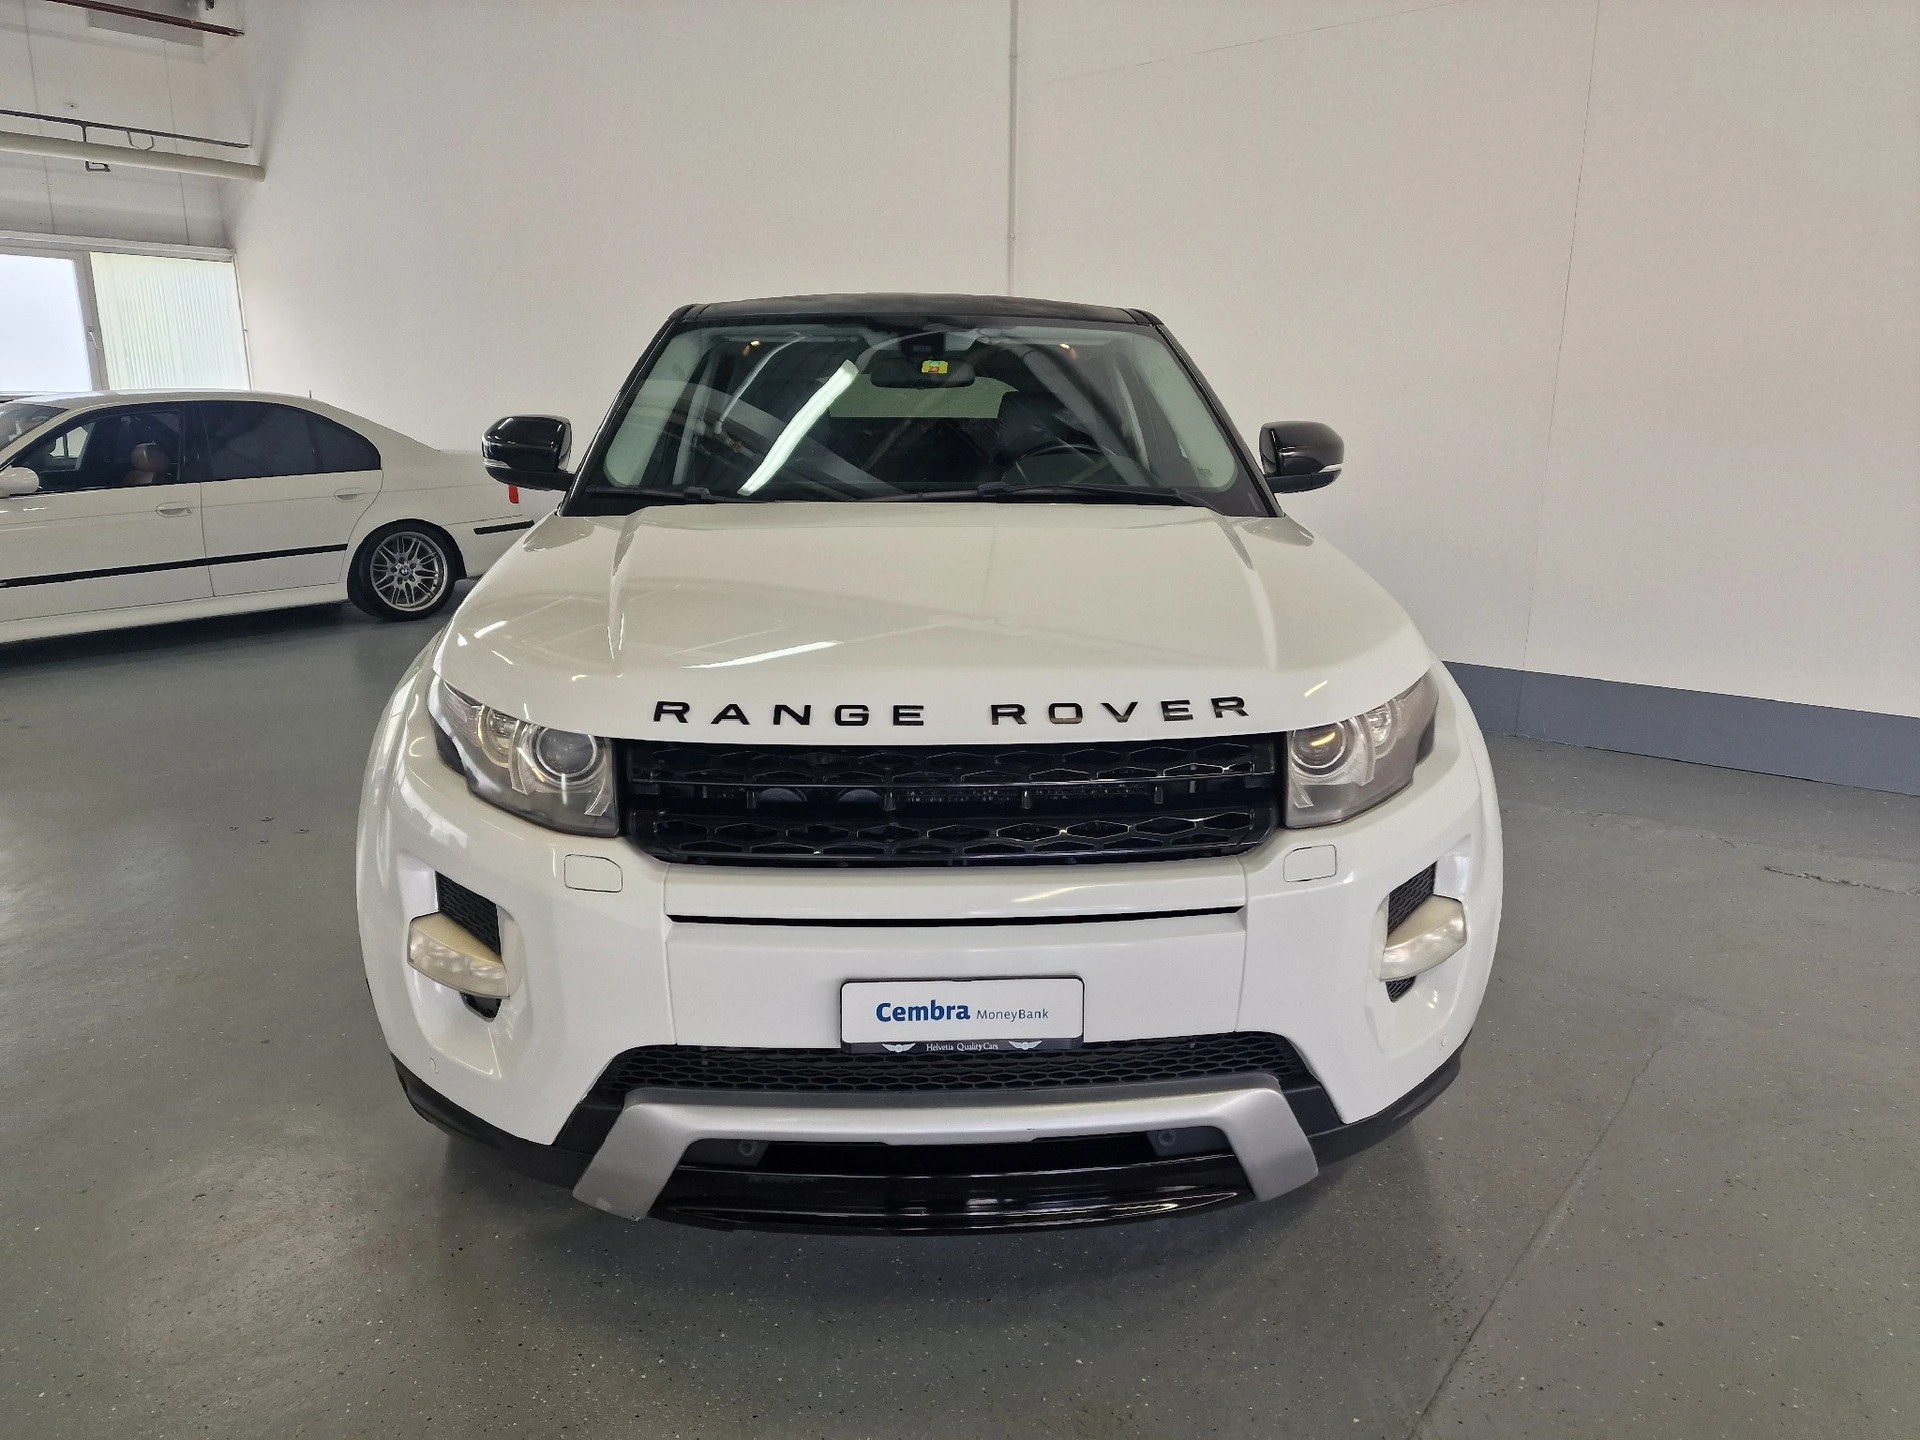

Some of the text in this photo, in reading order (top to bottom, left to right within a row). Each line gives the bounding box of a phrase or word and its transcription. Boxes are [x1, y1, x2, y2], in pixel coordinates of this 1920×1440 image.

[653, 696, 1250, 727] RANGE ROVER
[875, 1000, 1049, 1023] Cembra MoneyBank
[926, 1043, 954, 1052] Helvetia
